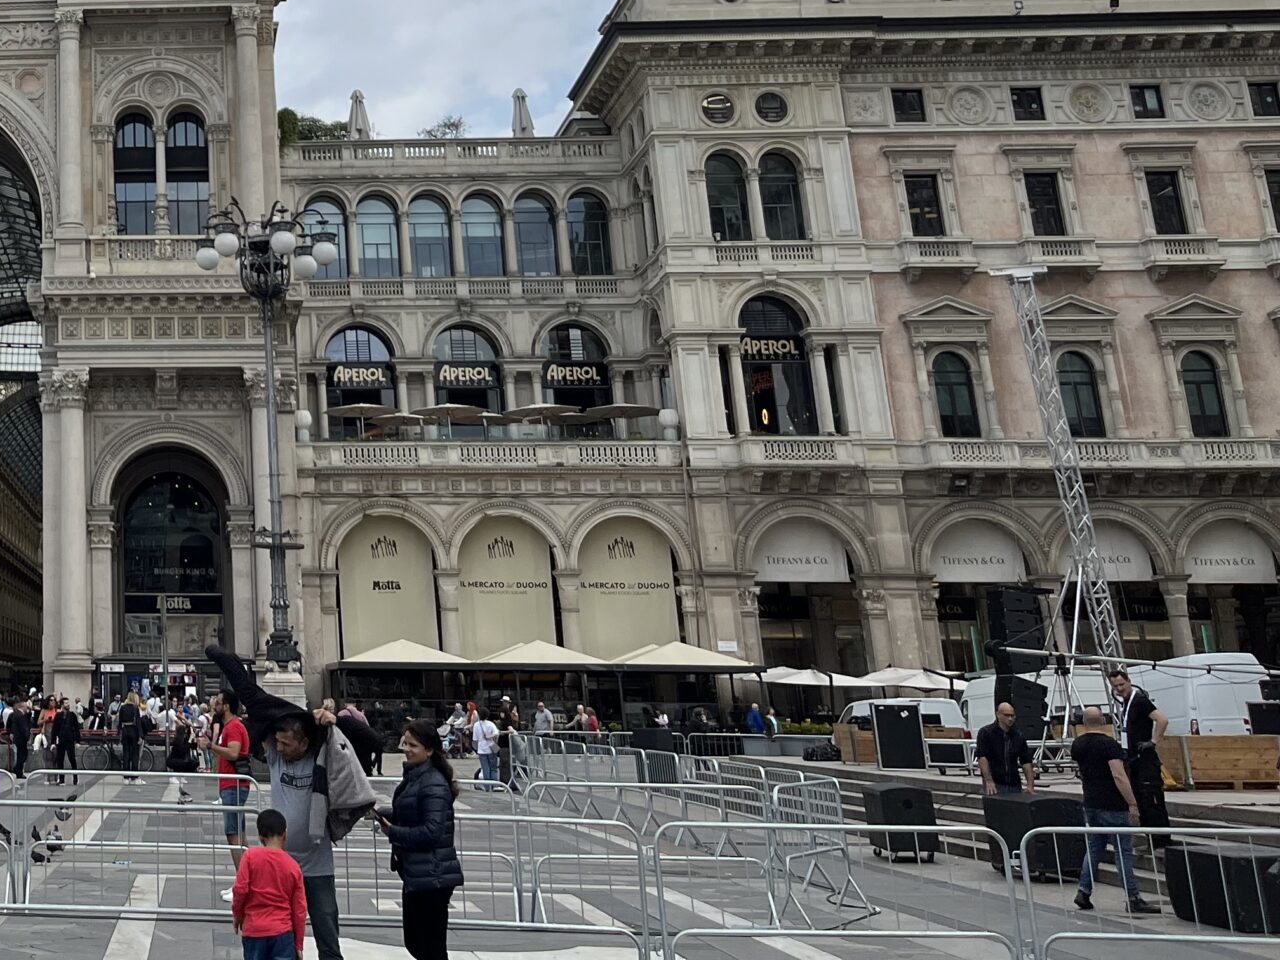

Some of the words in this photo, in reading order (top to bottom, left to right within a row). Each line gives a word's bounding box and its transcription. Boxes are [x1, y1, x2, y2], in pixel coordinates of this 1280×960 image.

[741, 337, 800, 354] APEROL
[333, 365, 386, 382] APEROL
[439, 364, 493, 381] APEROL
[546, 363, 601, 380] APEROL
[186, 567, 206, 576] KING
[372, 580, 402, 591] Motta
[468, 581, 505, 589] MERCATO
